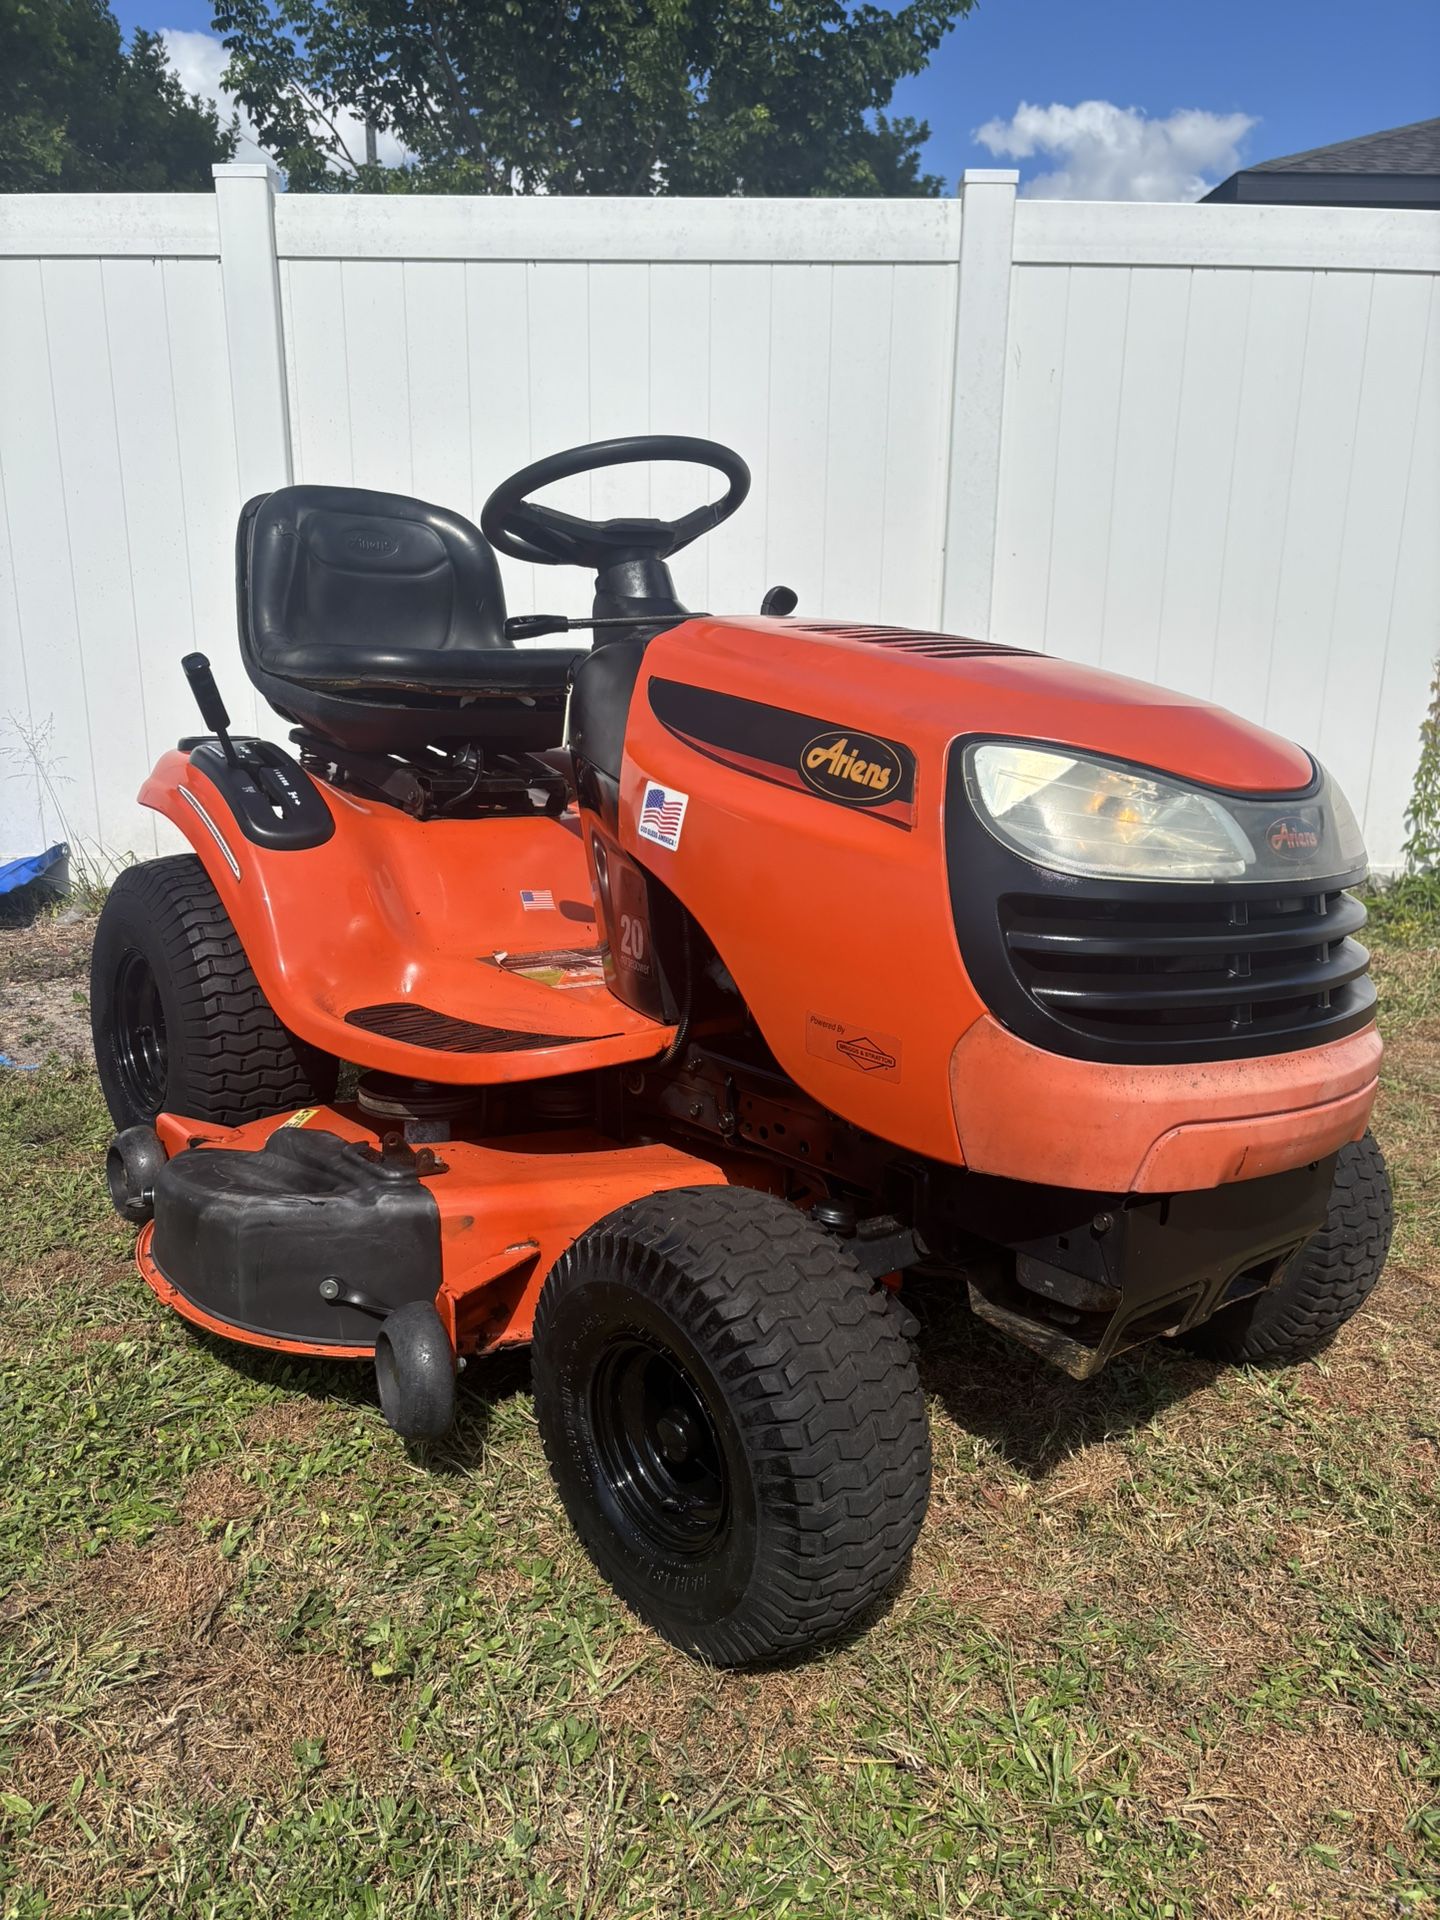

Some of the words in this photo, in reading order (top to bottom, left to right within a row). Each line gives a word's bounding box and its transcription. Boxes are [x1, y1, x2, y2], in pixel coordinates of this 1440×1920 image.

[806, 738, 891, 790] Ariens
[1271, 823, 1318, 850] Ariens
[620, 914, 644, 960] 20
[810, 1015, 837, 1031] Powered
[837, 1024, 846, 1034] By
[839, 1043, 860, 1055] BRIGGS
[865, 1052, 893, 1065] STRATTON
